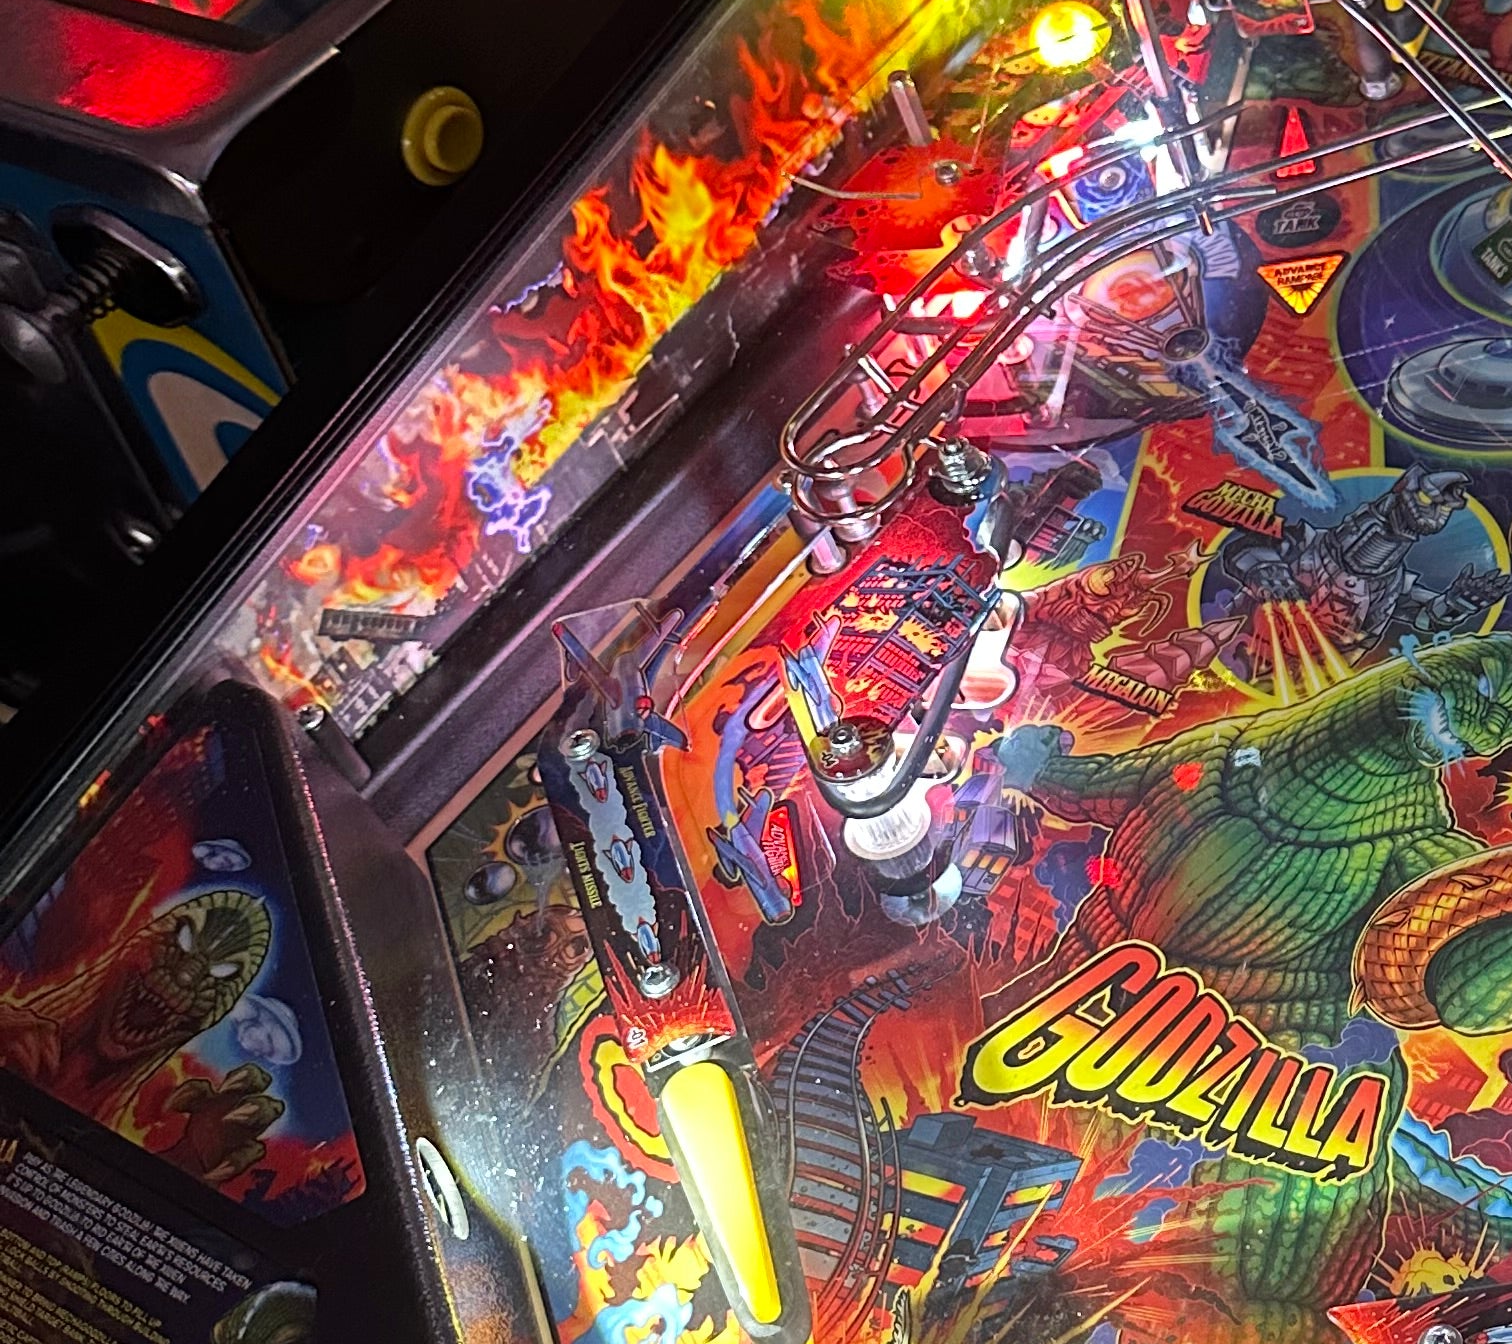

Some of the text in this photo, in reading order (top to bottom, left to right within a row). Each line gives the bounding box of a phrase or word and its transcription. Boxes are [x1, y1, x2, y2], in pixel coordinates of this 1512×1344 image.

[1273, 215, 1322, 235] TANK
[1274, 263, 1327, 278] ADVANCE
[1484, 247, 1508, 279] TANKS
[1187, 492, 1284, 540] GODZILLA
[1215, 481, 1277, 512] MECHA
[1083, 667, 1173, 713] MEGALON
[618, 765, 656, 839] ADVANCE FIGHTER
[570, 842, 602, 909] LIGHTS MISSILE
[970, 942, 1388, 1176] GODZILLA
[195, 1251, 223, 1273] HAVE
[218, 1264, 253, 1293] TAKEN
